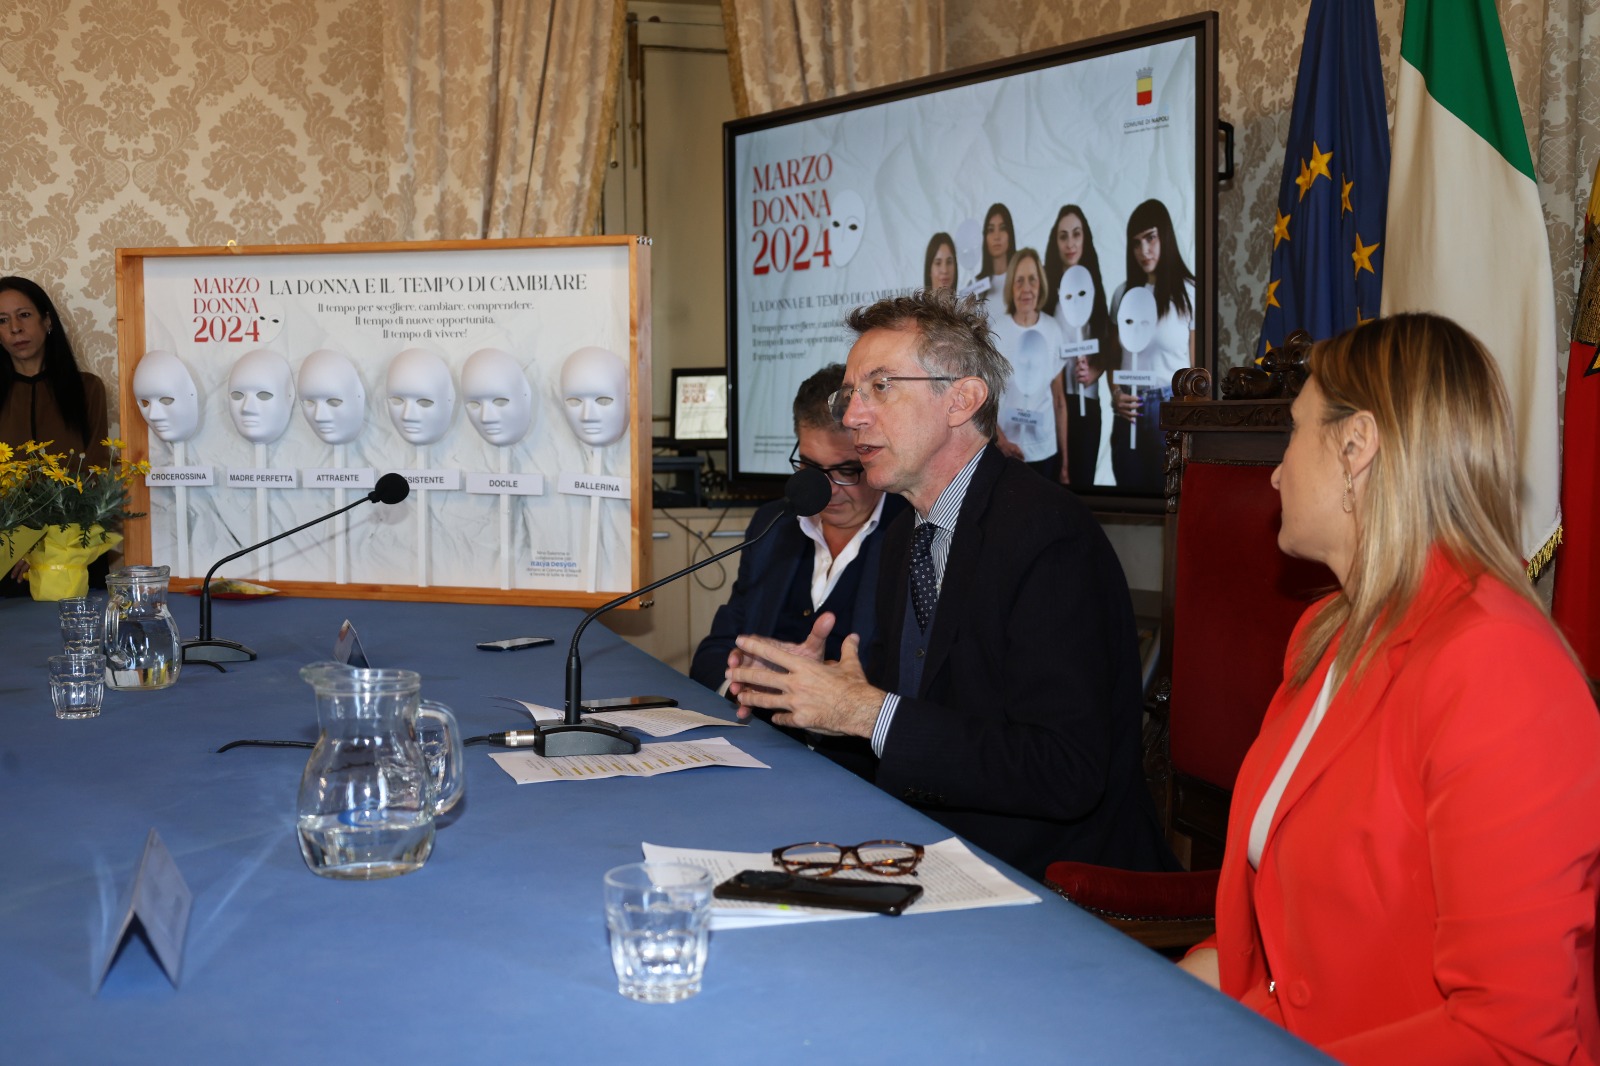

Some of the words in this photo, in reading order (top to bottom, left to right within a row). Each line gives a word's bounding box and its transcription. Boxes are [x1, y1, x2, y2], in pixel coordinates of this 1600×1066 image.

[753, 153, 833, 194] MARZO
[753, 189, 831, 228] DONNA
[752, 224, 832, 276] 2024
[193, 277, 260, 294] MARZO
[270, 280, 292, 295] LA
[297, 278, 360, 295] DONNA
[365, 278, 376, 294] E
[380, 278, 394, 293] IL
[399, 276, 464, 293] TEMPO
[468, 276, 486, 292] DI
[490, 274, 587, 292] CAMBIARE
[193, 297, 259, 314] DONNA
[816, 294, 849, 307] TEMPO
[318, 303, 323, 312] Il
[326, 304, 355, 315] tempo
[357, 304, 374, 314] per
[355, 316, 360, 325] Il
[363, 317, 393, 328] tempo
[395, 316, 403, 325] di
[193, 316, 260, 343] 2024
[383, 329, 388, 339] Il
[391, 331, 421, 341] tempo
[423, 330, 432, 338] di
[435, 328, 467, 338] vivere!
[151, 473, 206, 481] CROCEROSSINA
[229, 474, 255, 482] MADRE
[316, 474, 359, 482] ATTRAENTE
[404, 476, 444, 484] SISTENTE
[489, 480, 518, 488] DOCILE
[574, 481, 620, 492] BALLERINA
